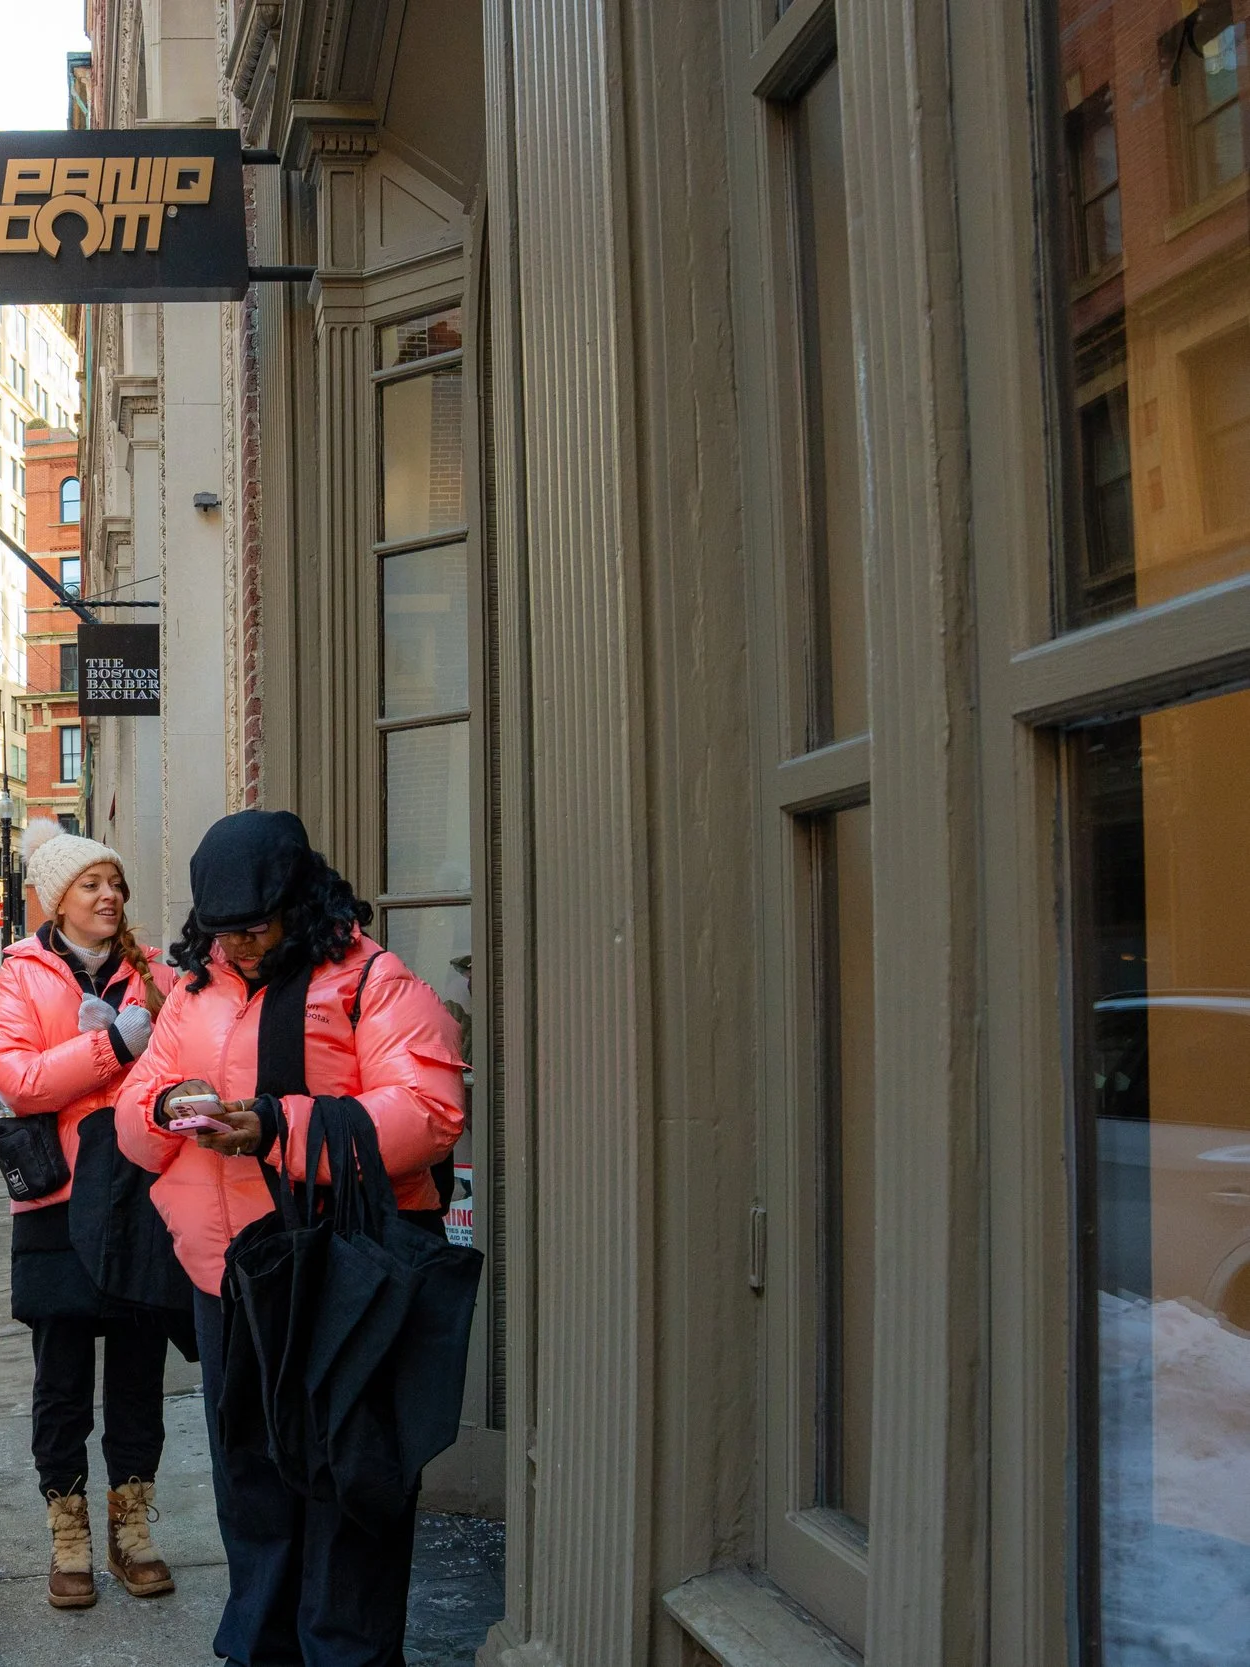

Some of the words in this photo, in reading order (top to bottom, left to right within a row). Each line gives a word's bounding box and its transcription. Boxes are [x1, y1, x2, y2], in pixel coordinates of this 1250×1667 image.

[2, 157, 214, 205] PANIQ
[86, 658, 124, 668] THE
[86, 669, 159, 679] BOSTON
[86, 679, 159, 689] BARBER
